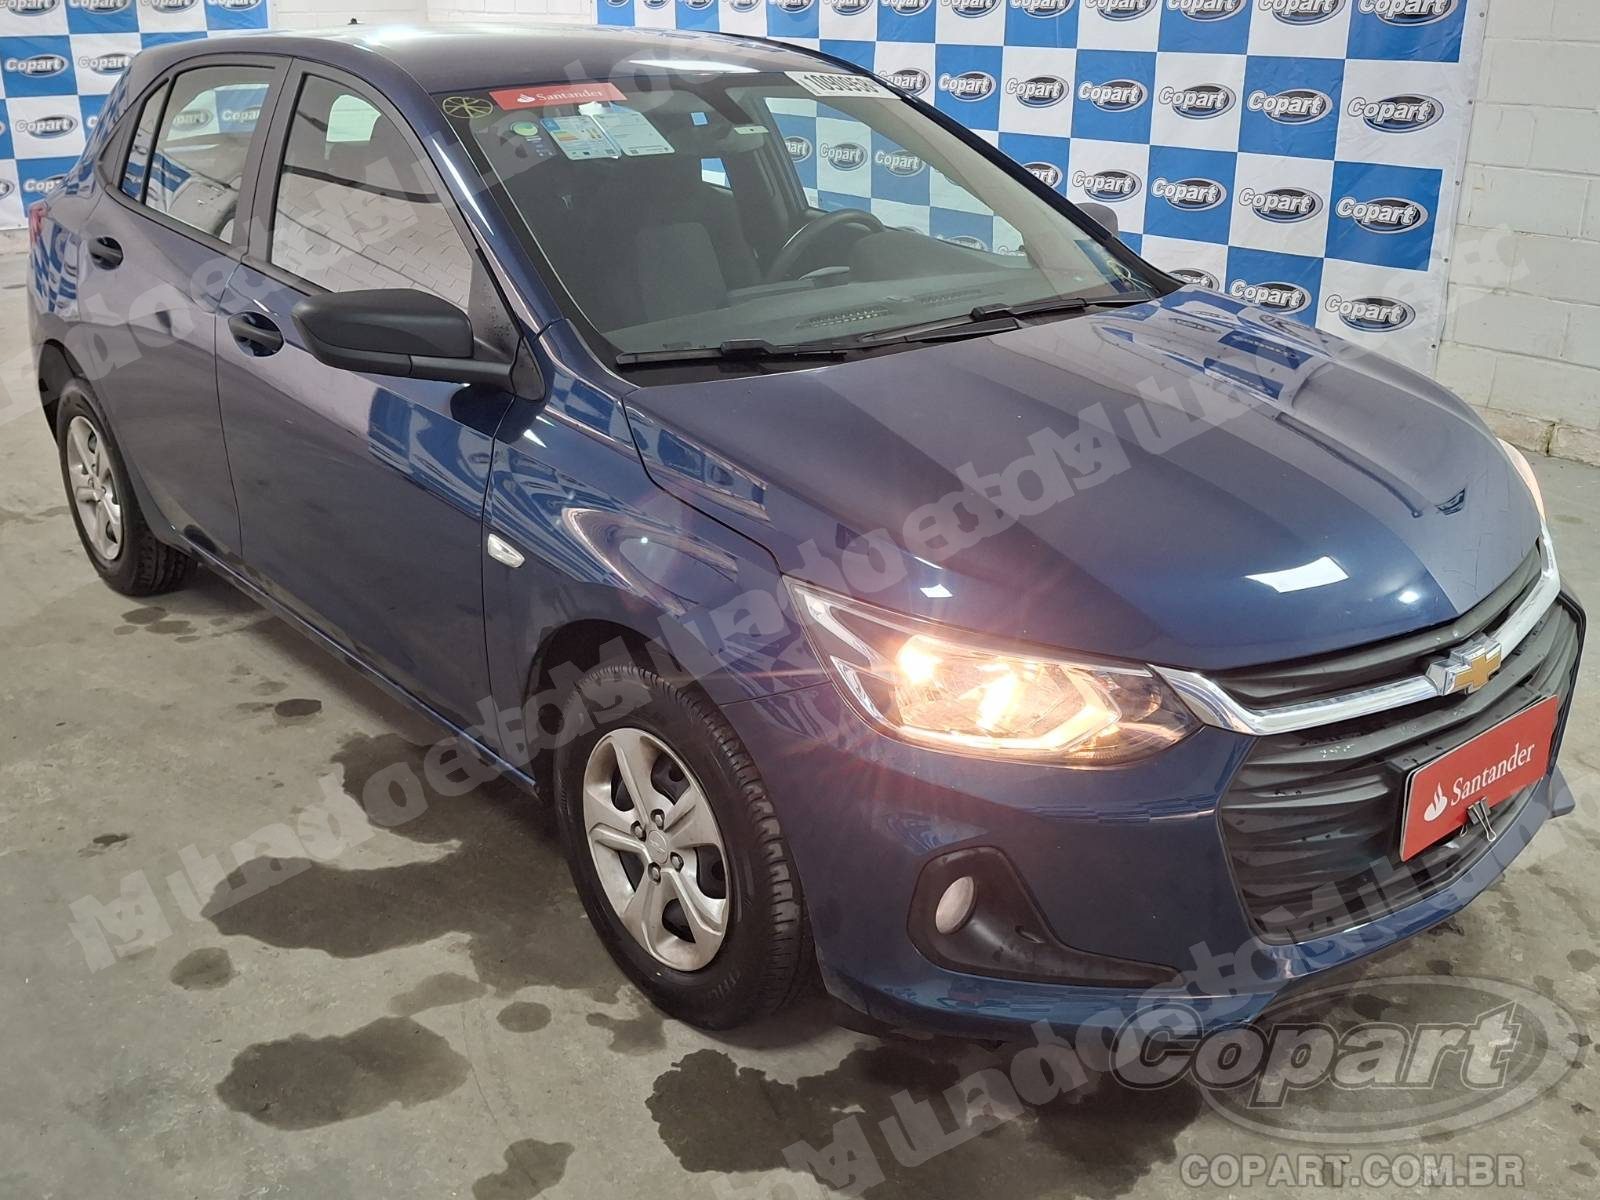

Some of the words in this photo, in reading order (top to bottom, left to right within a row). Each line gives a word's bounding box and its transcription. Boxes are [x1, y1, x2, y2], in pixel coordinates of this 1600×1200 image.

[1358, 0, 1446, 19] Copart
[4, 57, 61, 72] Copart
[536, 87, 604, 101] Santander
[938, 72, 990, 97] Copart
[1006, 78, 1062, 99] Copart
[1078, 81, 1140, 104] Copart
[1159, 87, 1227, 110] Copart
[1248, 90, 1323, 118] Copart
[1347, 97, 1433, 124] Copart
[15, 118, 71, 135] Copart
[820, 142, 861, 161] Copart
[874, 150, 920, 170] Copart
[1072, 170, 1133, 194] Copart
[1152, 177, 1218, 203] Copart
[1239, 187, 1312, 214] Copart
[1335, 197, 1418, 225] Copart
[1231, 278, 1303, 308] Copart
[1324, 294, 1404, 325] Copart
[1451, 743, 1535, 806] Santander
